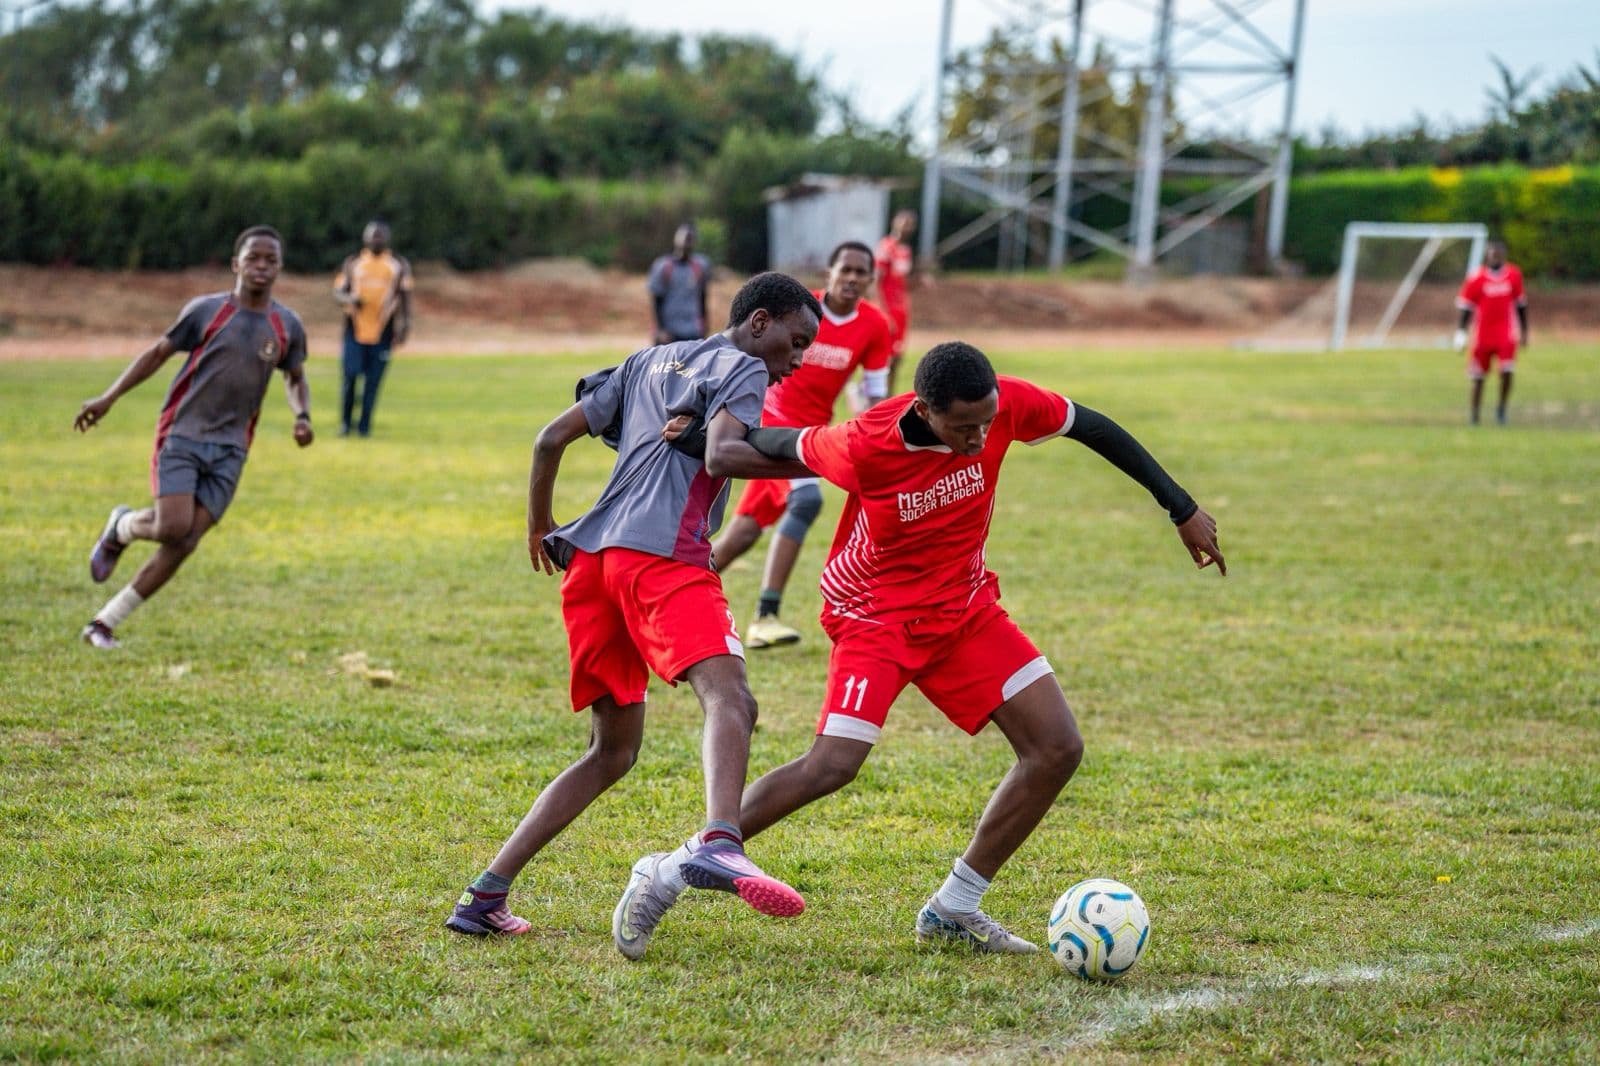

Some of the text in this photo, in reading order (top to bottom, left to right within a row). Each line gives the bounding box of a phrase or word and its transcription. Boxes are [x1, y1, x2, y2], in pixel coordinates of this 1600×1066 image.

[897, 462, 984, 510] MERISHAW
[900, 478, 985, 522] SOCCER ACADEMY
[841, 674, 869, 712] 11
